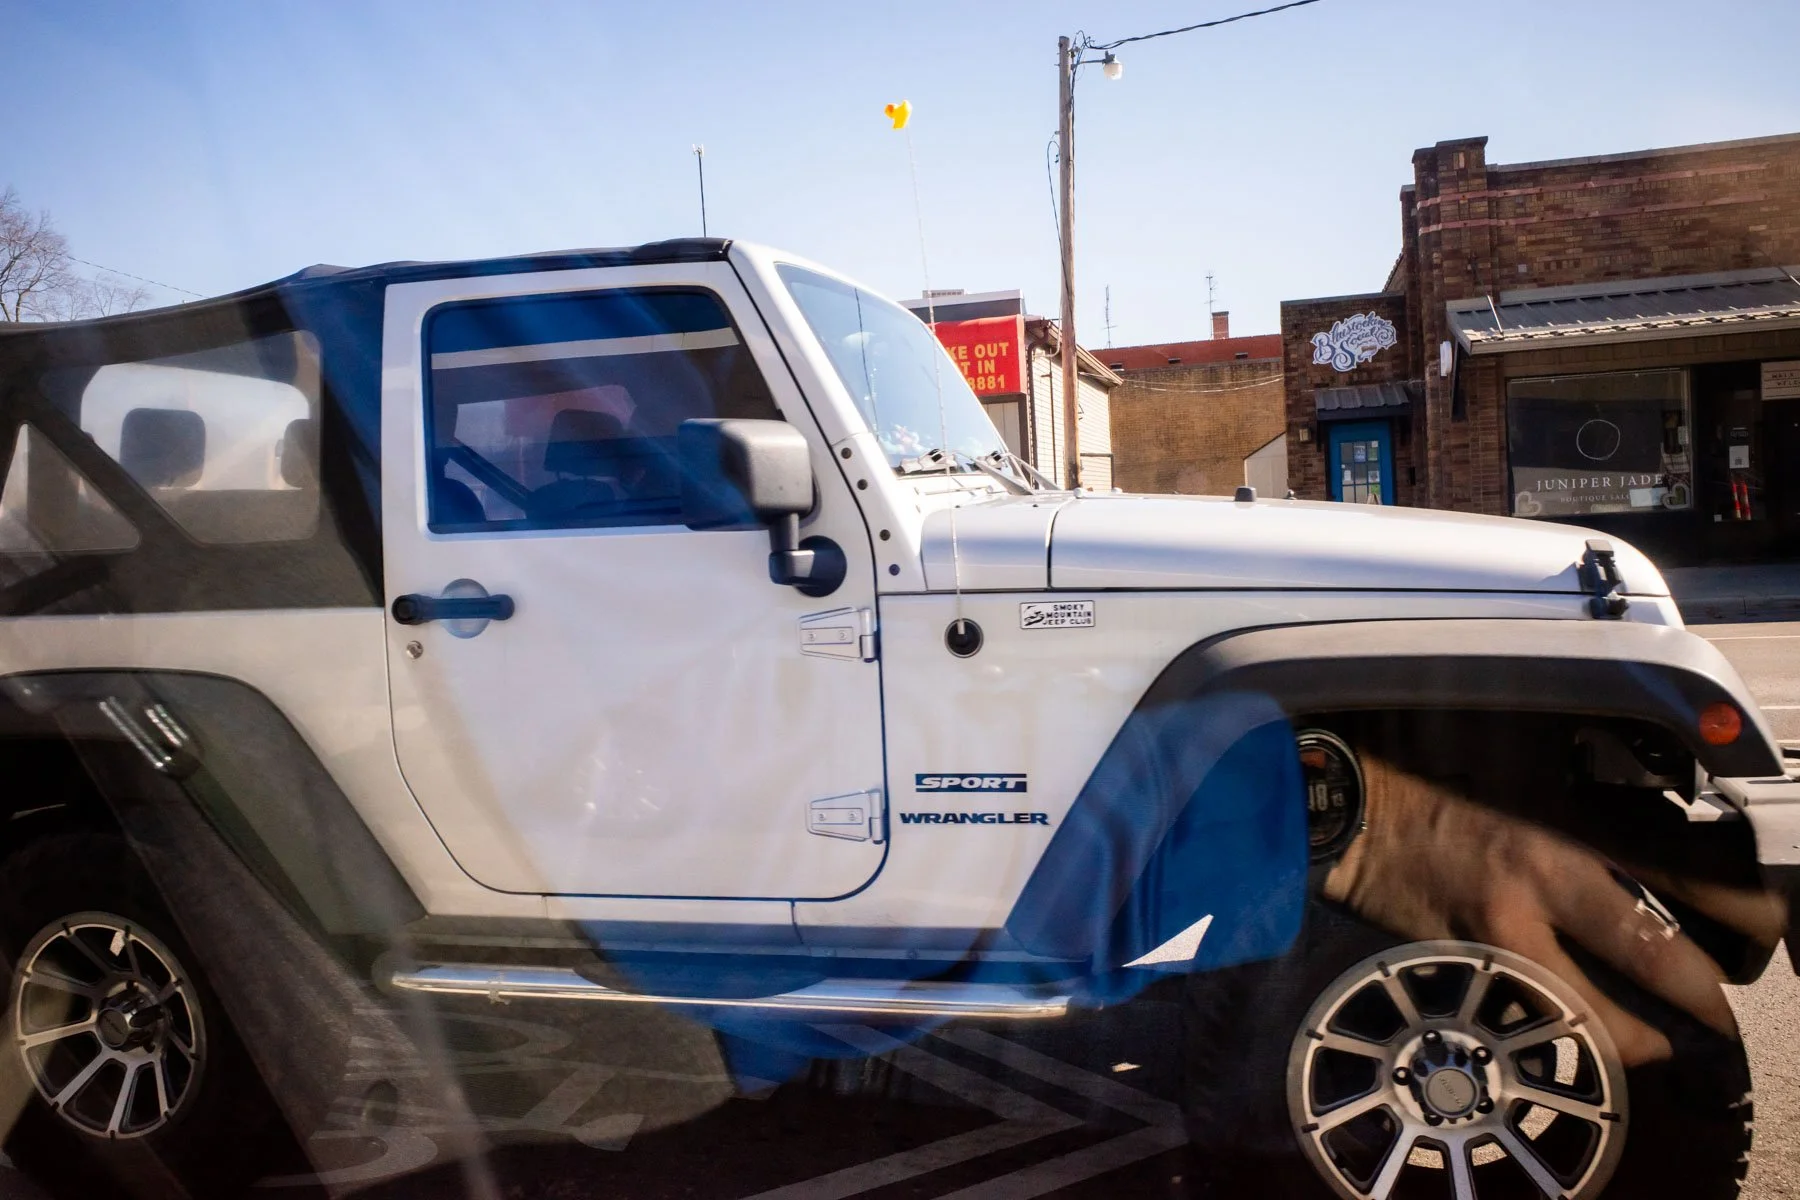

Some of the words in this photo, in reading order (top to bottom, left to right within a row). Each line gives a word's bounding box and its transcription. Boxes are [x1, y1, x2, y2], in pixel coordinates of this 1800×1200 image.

[945, 345, 968, 360] KE
[974, 342, 1009, 358] OUT
[977, 359, 996, 374] IN
[967, 374, 1005, 391] 8881
[1537, 476, 1611, 492] JUNIPER
[1620, 473, 1664, 489] JADE
[917, 776, 1026, 789] SPORT
[900, 813, 1050, 825] WRANGLER
